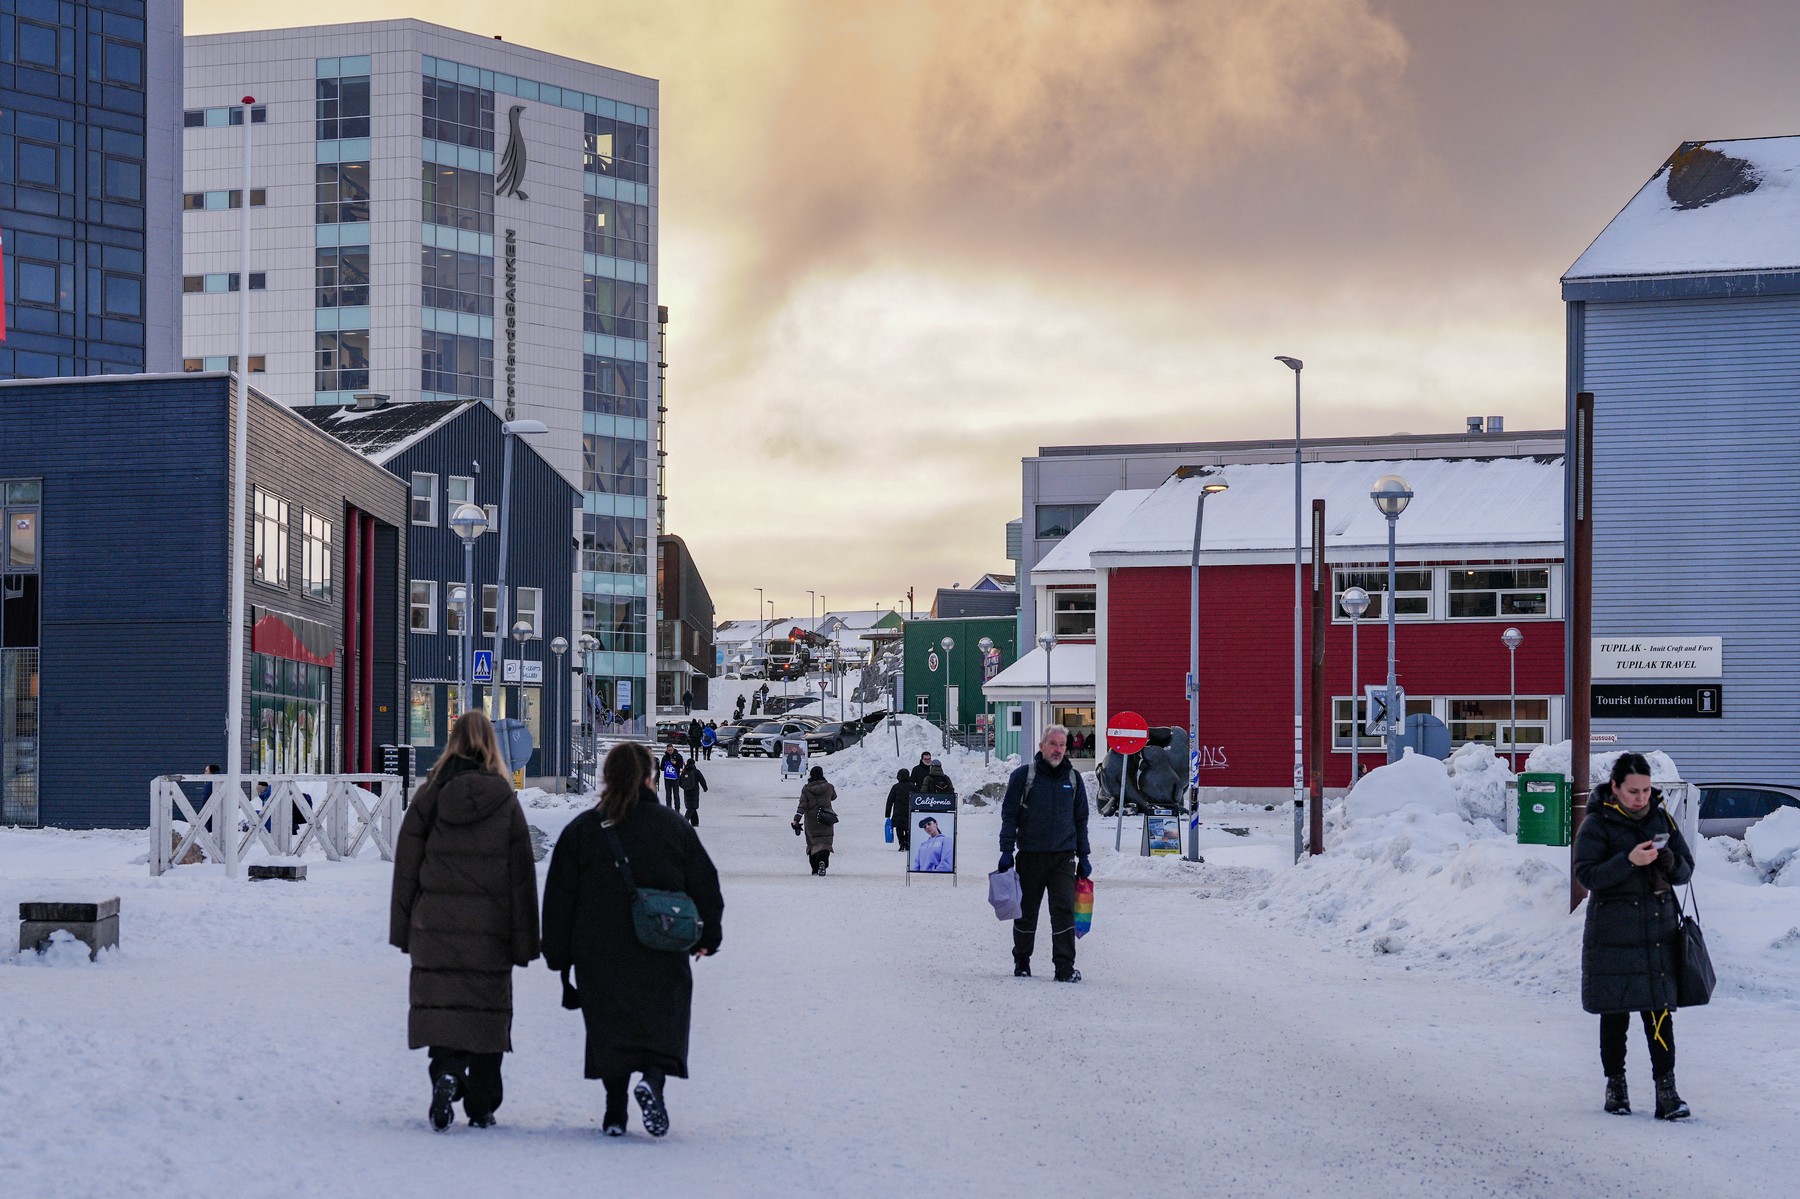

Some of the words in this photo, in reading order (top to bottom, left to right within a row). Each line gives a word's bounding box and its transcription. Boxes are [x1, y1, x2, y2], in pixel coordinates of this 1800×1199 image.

[1600, 644, 1641, 652] TUPILAK
[1667, 645, 1683, 653] Craft
[1616, 661, 1657, 669] TUPILAK
[1660, 661, 1697, 669] TRAVEL
[1596, 695, 1631, 705] Tourist
[1634, 695, 1693, 705] information
[915, 796, 951, 807] California
